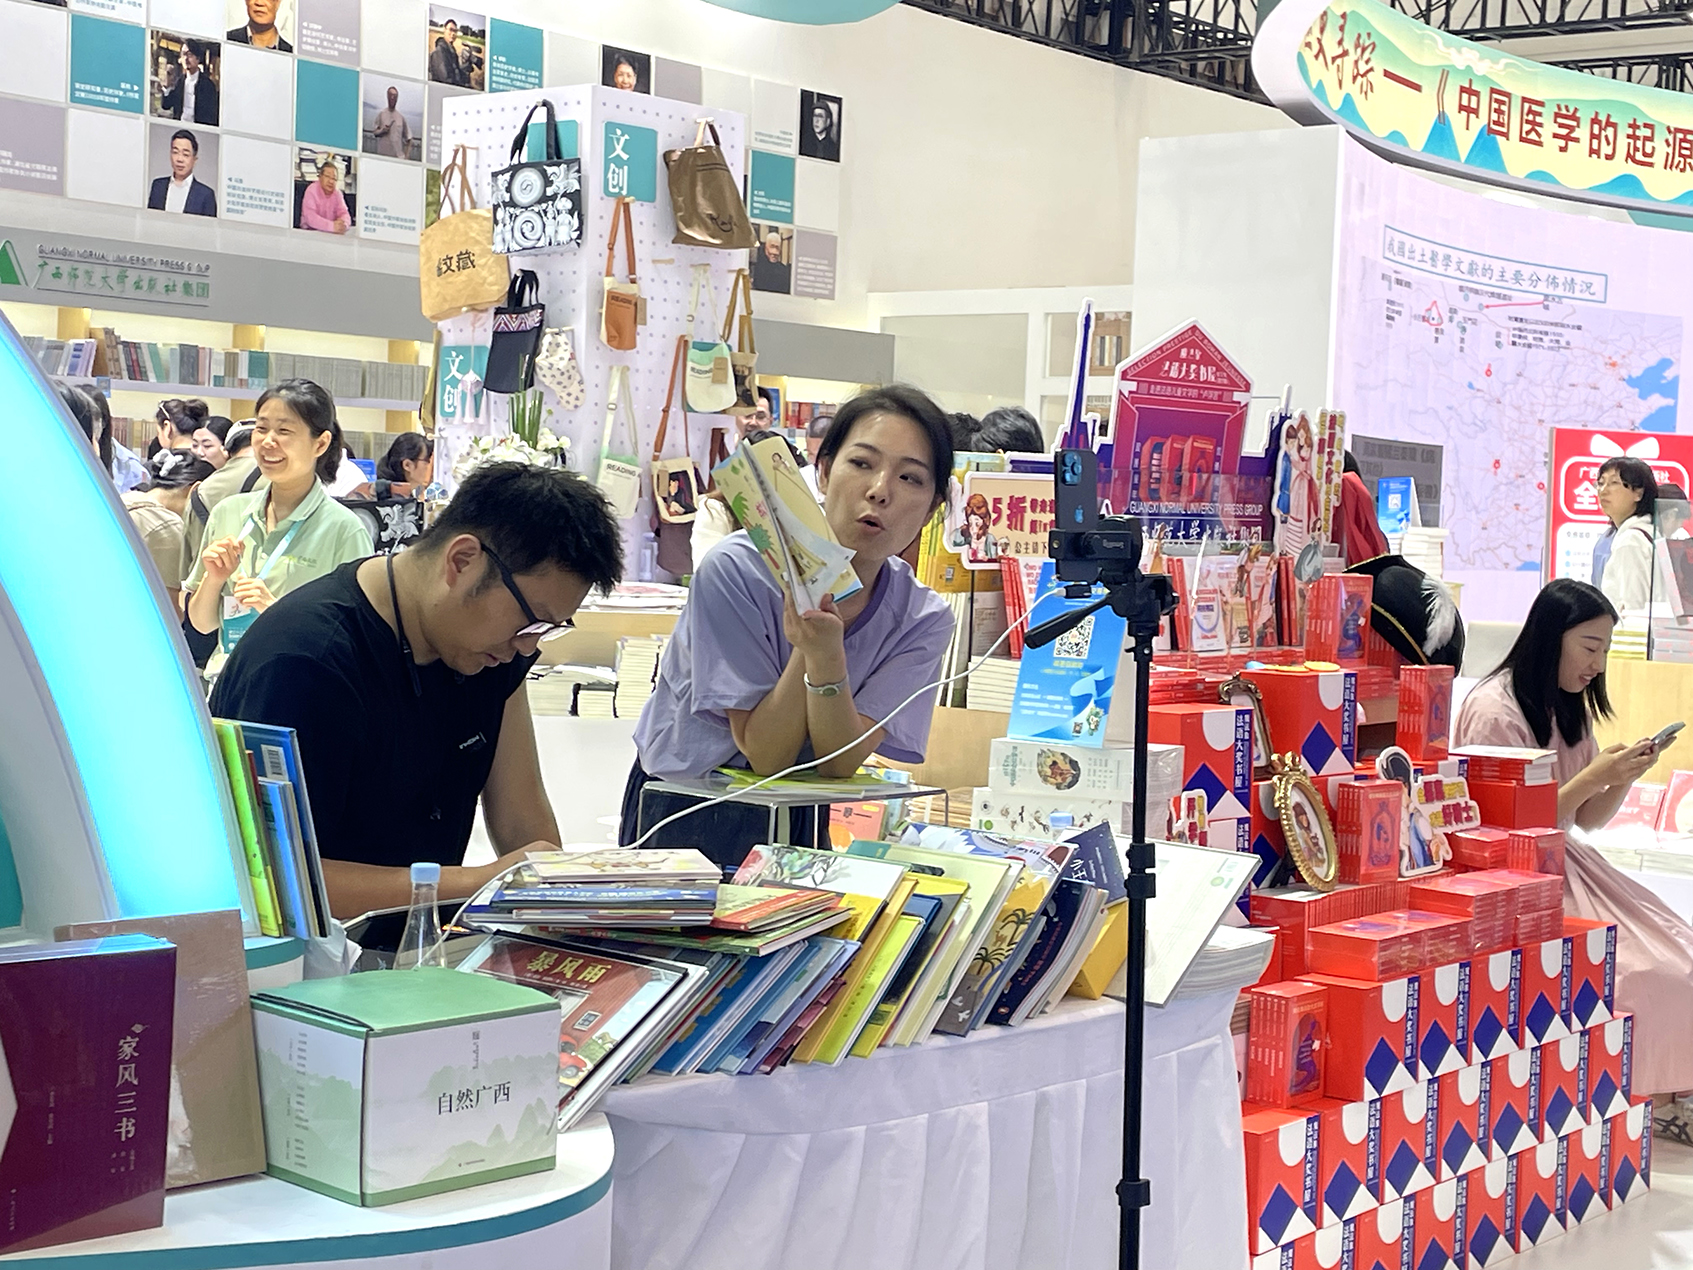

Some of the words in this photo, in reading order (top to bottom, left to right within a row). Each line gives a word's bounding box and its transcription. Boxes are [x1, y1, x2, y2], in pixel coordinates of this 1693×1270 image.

[607, 129, 630, 196] 文创
[159, 258, 185, 272] PRESS
[606, 462, 637, 478] READING
[992, 494, 1028, 532] 5折
[1223, 503, 1244, 515] PRESS
[1245, 504, 1263, 516] GROUP
[526, 950, 612, 984] 暴风雨
[113, 1035, 140, 1142] 家风三书
[437, 1081, 512, 1116] 自然广西
